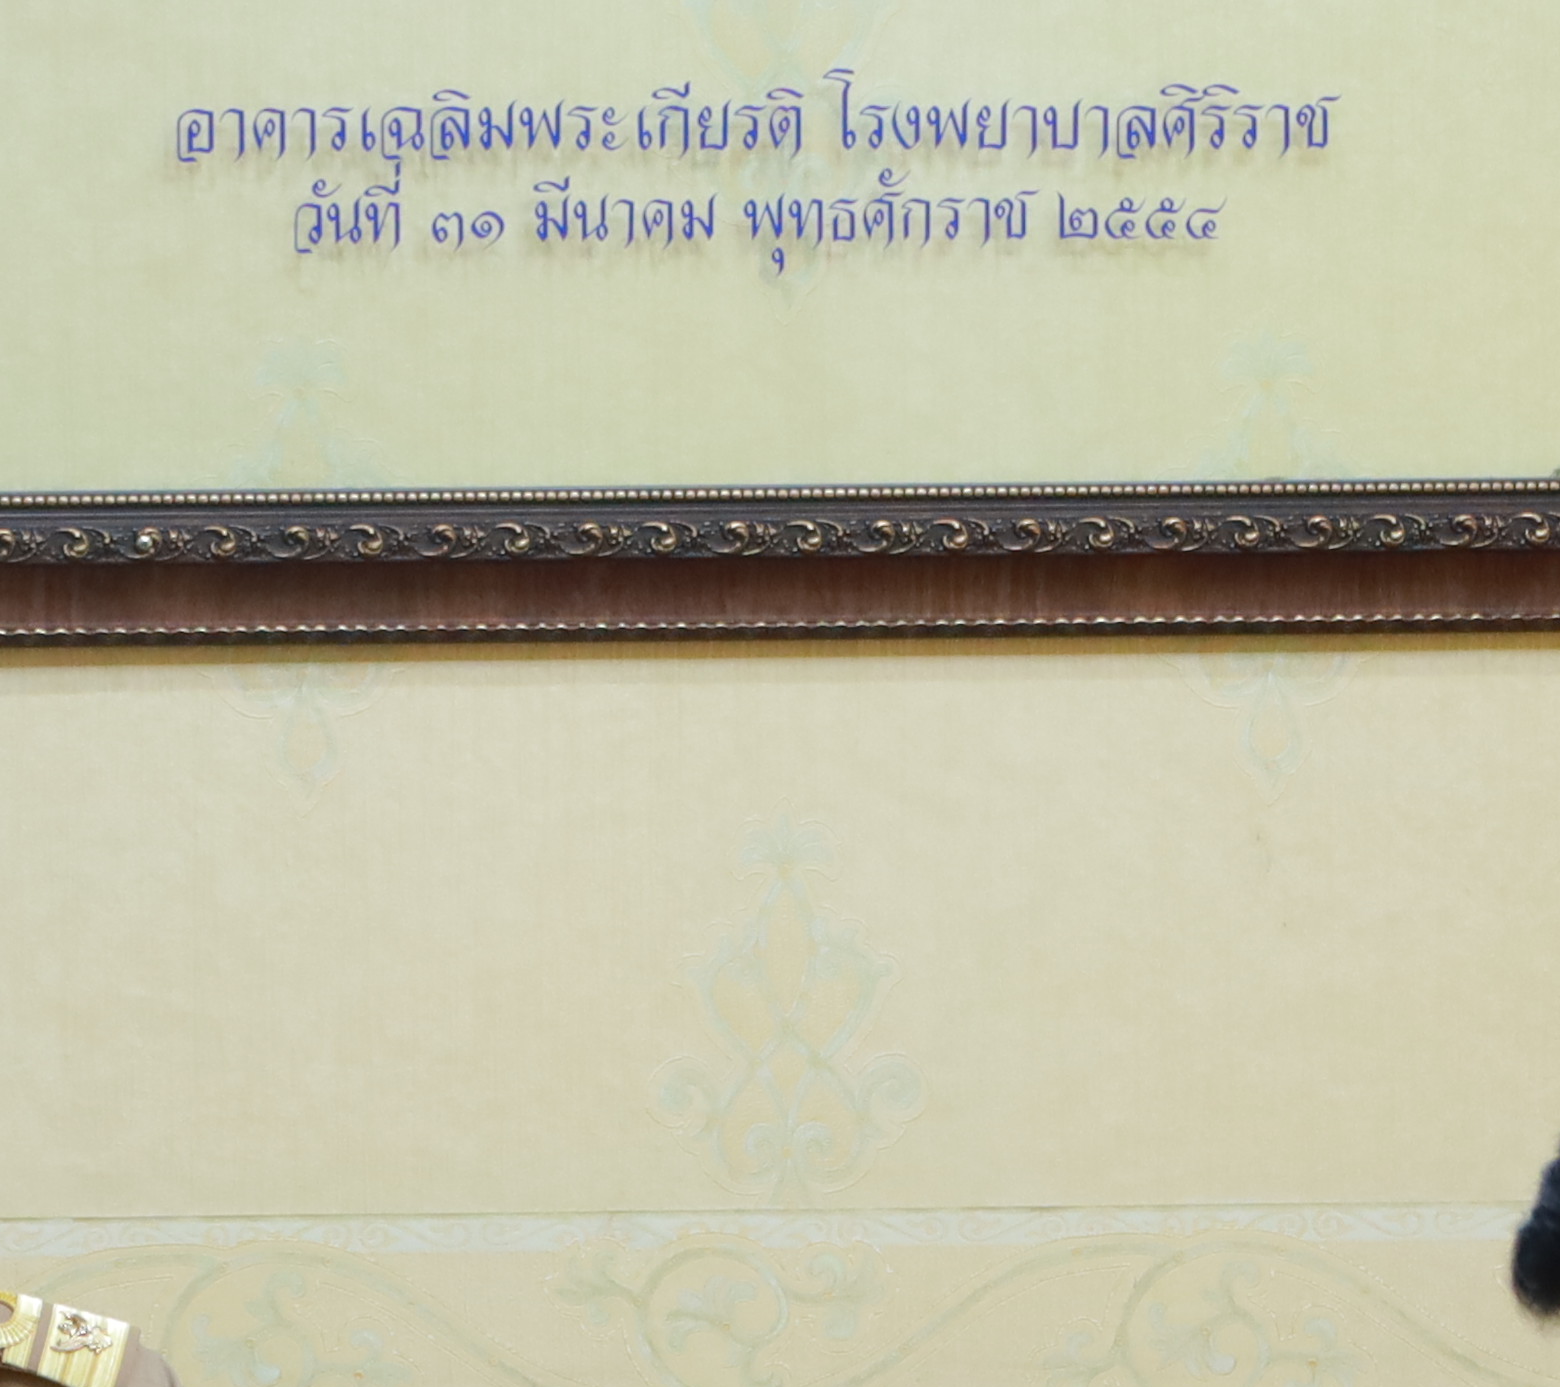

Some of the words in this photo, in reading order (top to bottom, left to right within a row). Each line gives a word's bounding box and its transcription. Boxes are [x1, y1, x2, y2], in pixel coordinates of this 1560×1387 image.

[176, 81, 806, 164] อาคารเฉลิมพระเกียรติ
[824, 67, 1341, 161] โรงพยาบาลศิริราช
[293, 178, 404, 255] วันที่
[431, 209, 507, 247] ๓๑
[533, 176, 718, 253] มีนาคม
[742, 167, 1040, 276] พุทธศักราช
